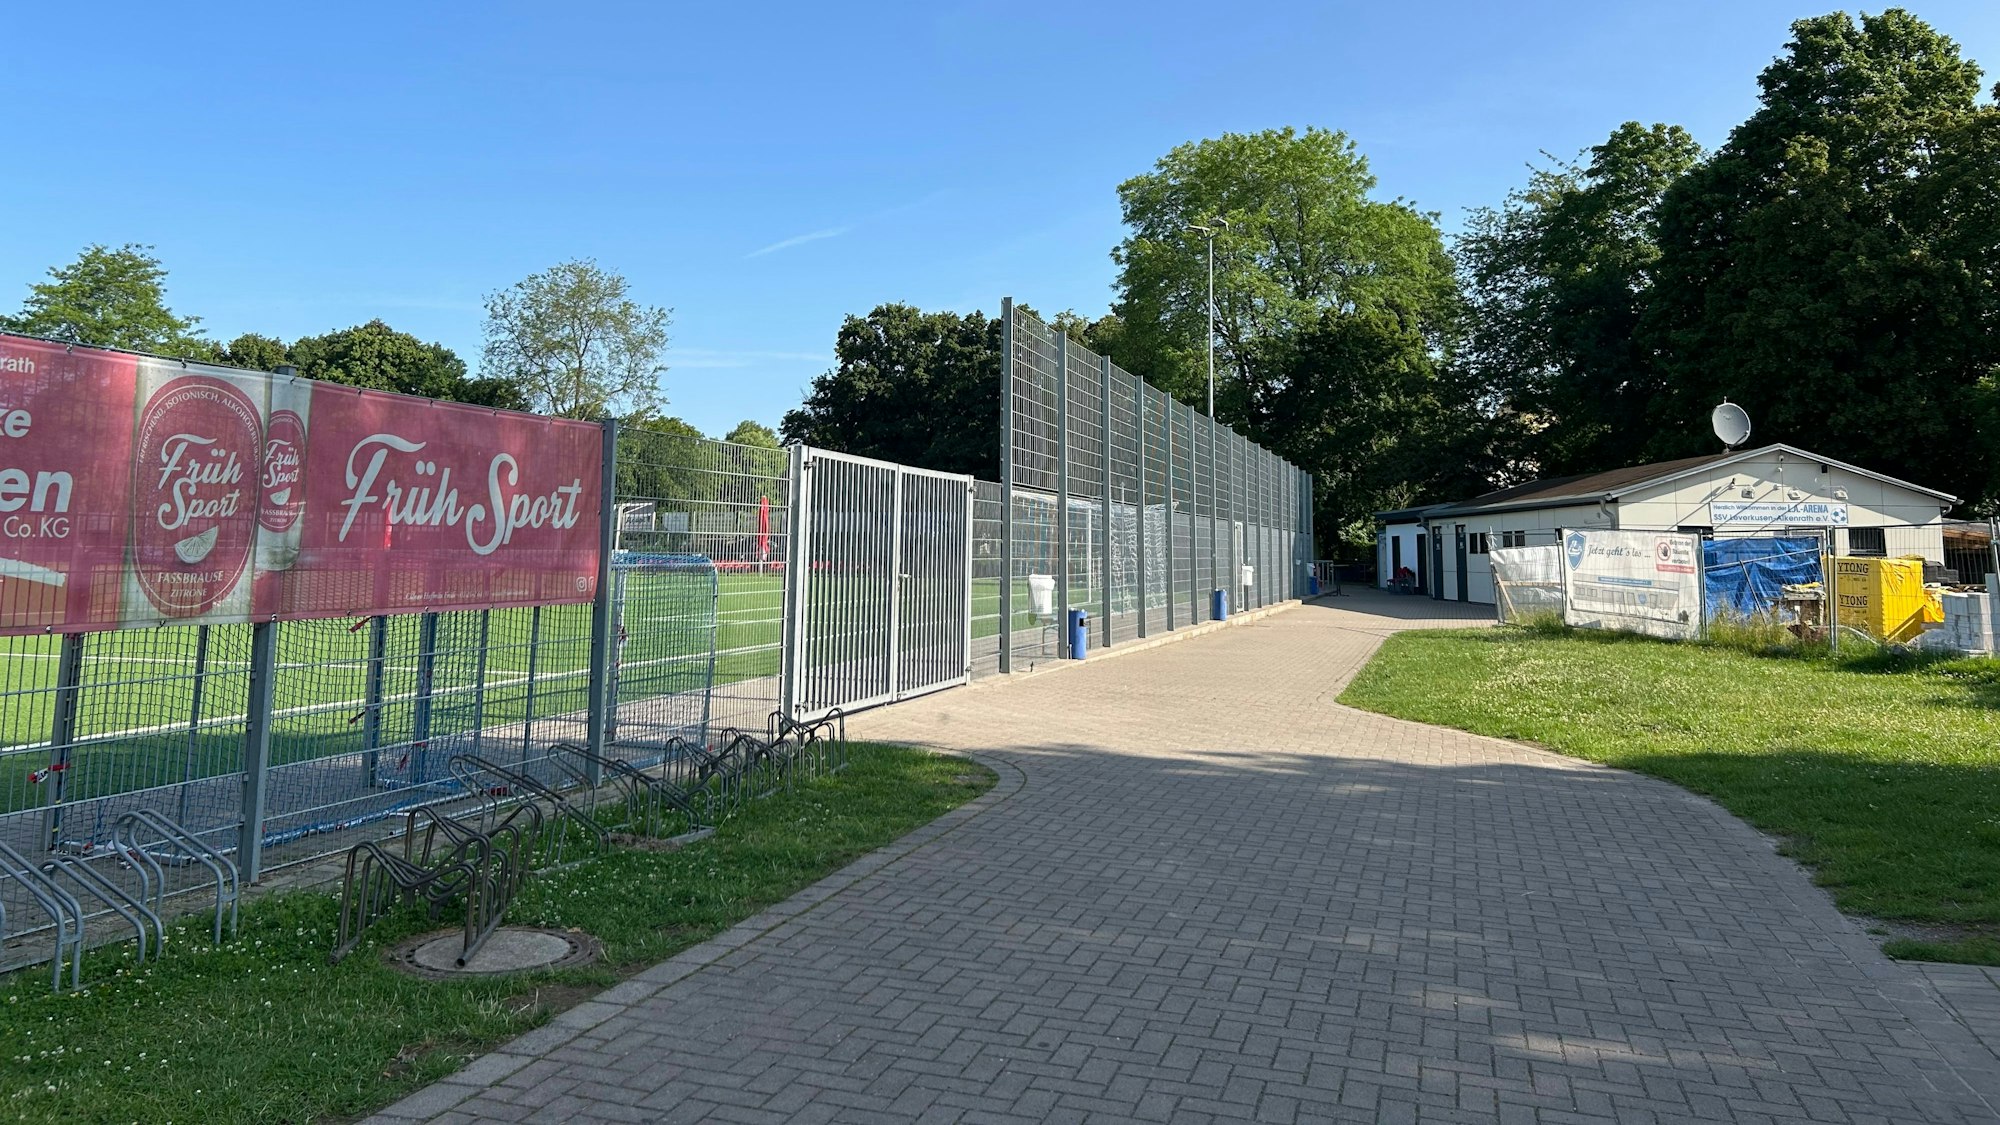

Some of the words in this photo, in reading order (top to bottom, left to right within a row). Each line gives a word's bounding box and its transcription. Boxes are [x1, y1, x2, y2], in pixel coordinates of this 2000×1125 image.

[165, 390, 220, 410] ISOTONISCH,
[158, 433, 244, 490] Früh
[264, 439, 300, 466] Früh
[262, 461, 300, 489] Sport
[0, 468, 73, 513] en
[338, 433, 465, 543] Früh
[465, 453, 583, 556] Sport
[157, 477, 241, 531] Sport
[4, 515, 36, 538] Co.
[40, 517, 70, 539] KG
[1713, 513, 1728, 521] SSV
[1587, 544, 1605, 557] Jetzt
[157, 569, 224, 584] FASSBRAUSE
[1837, 562, 1869, 574] YTONG
[171, 588, 208, 598] ZITRONE
[1839, 594, 1868, 606] YTONG
